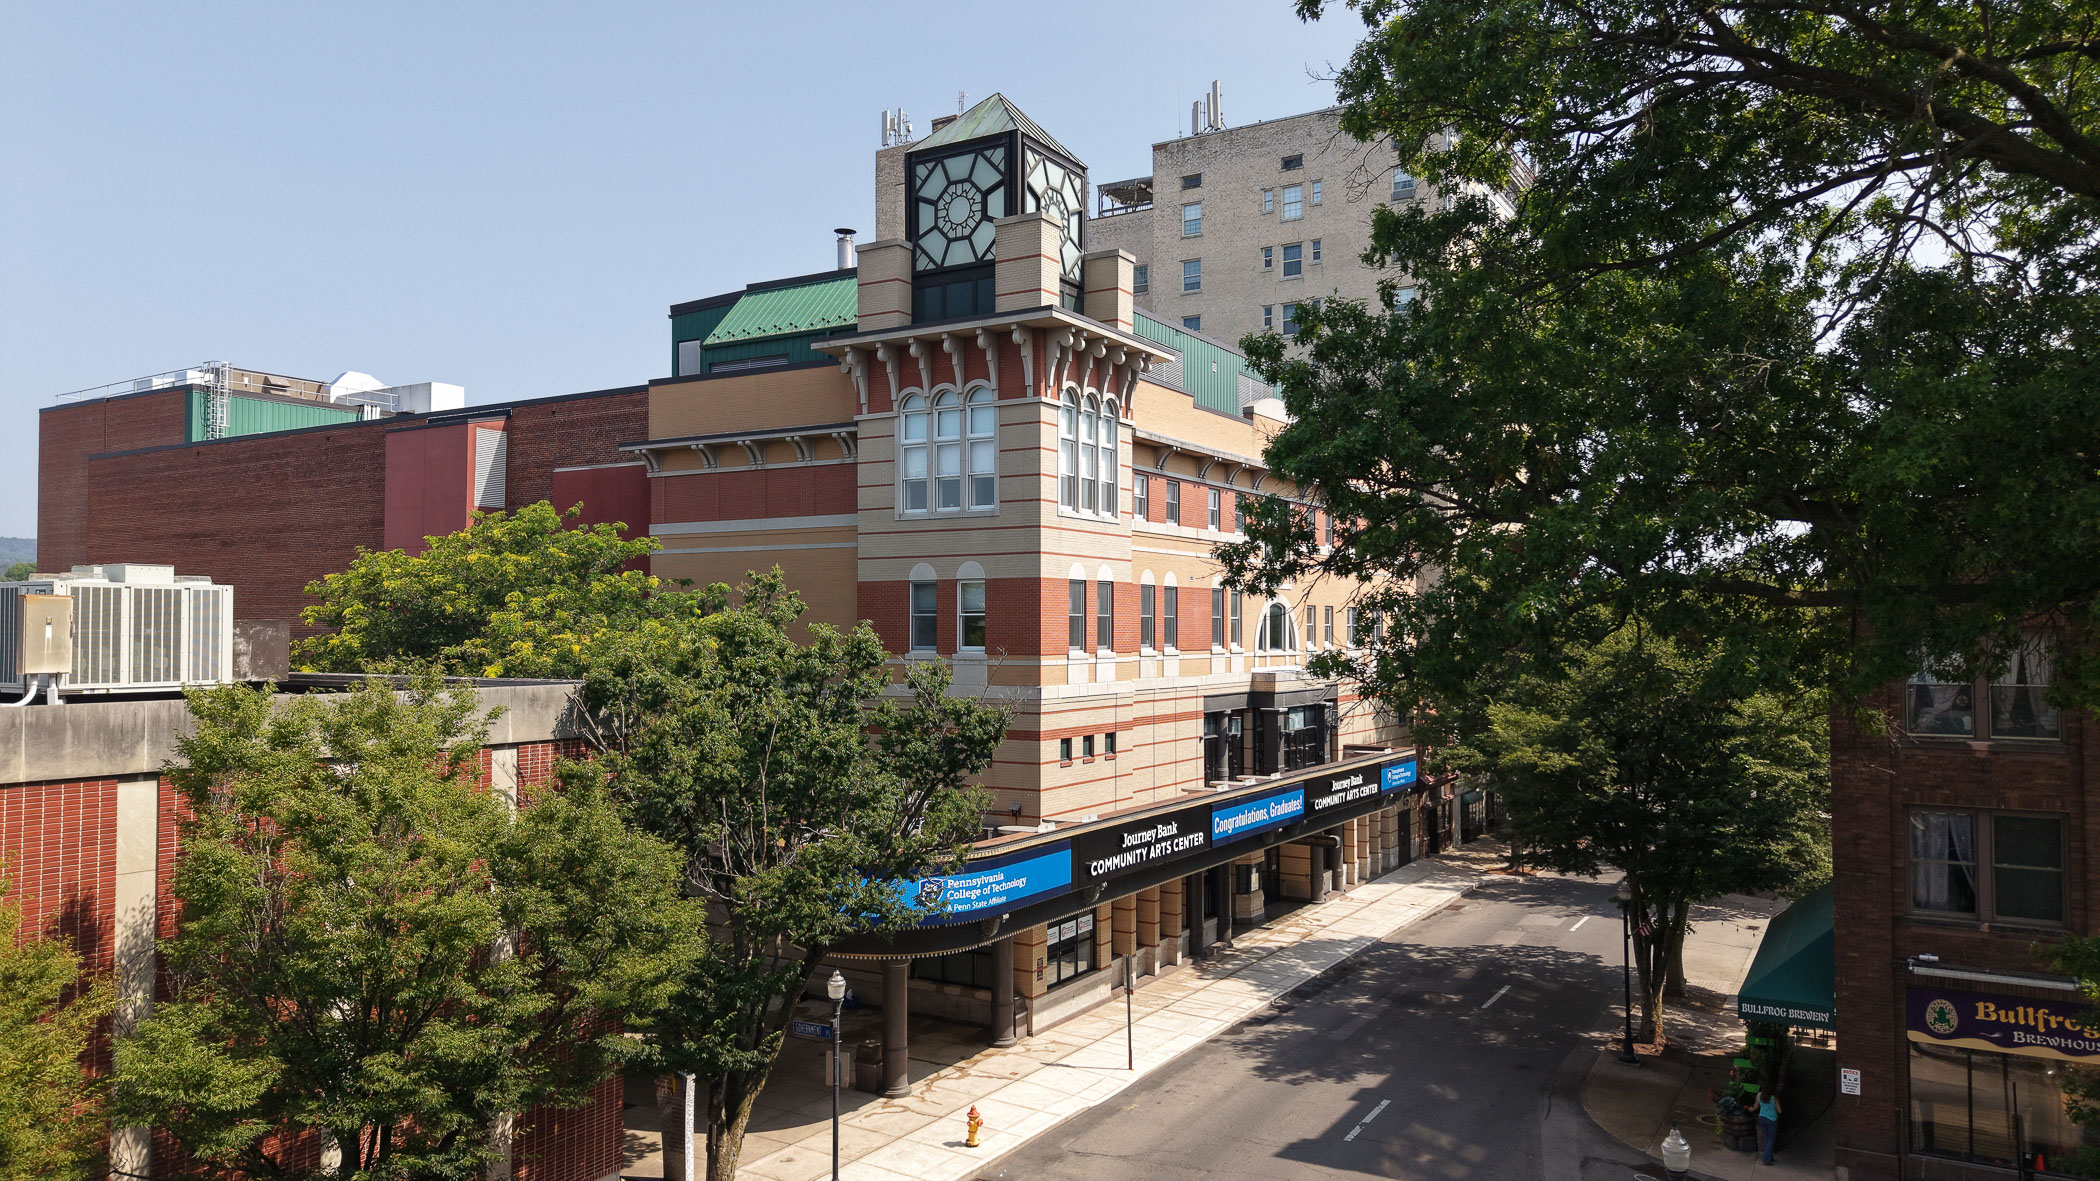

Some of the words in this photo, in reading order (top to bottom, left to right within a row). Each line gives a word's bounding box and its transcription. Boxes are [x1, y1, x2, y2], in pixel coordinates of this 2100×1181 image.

[1332, 777, 1350, 792] Journey
[1350, 774, 1363, 786] Bank
[1314, 791, 1346, 810] COMMUNITY
[1346, 788, 1360, 801] ARTS
[1360, 784, 1378, 796] CENTER
[1214, 807, 1269, 834] Congratulations,
[1270, 794, 1302, 818] Graduates!
[1122, 828, 1157, 848] Journey
[1157, 821, 1178, 838] Bank
[1090, 847, 1148, 876] COMMUNITY
[1150, 841, 1172, 859] ARTS
[1173, 832, 1204, 852] CENTER
[946, 888, 982, 900] College
[982, 884, 992, 895] of
[992, 876, 1027, 894] Technology
[947, 871, 1004, 888] Pennsylvania
[946, 904, 952, 912] A
[954, 902, 971, 912] Penn
[972, 900, 988, 909] State
[988, 896, 1007, 906] Affiliate
[1742, 1002, 1787, 1018] BULLFROG
[1788, 1008, 1830, 1023] BREWERY
[795, 1022, 821, 1036] GOVERNMENT
